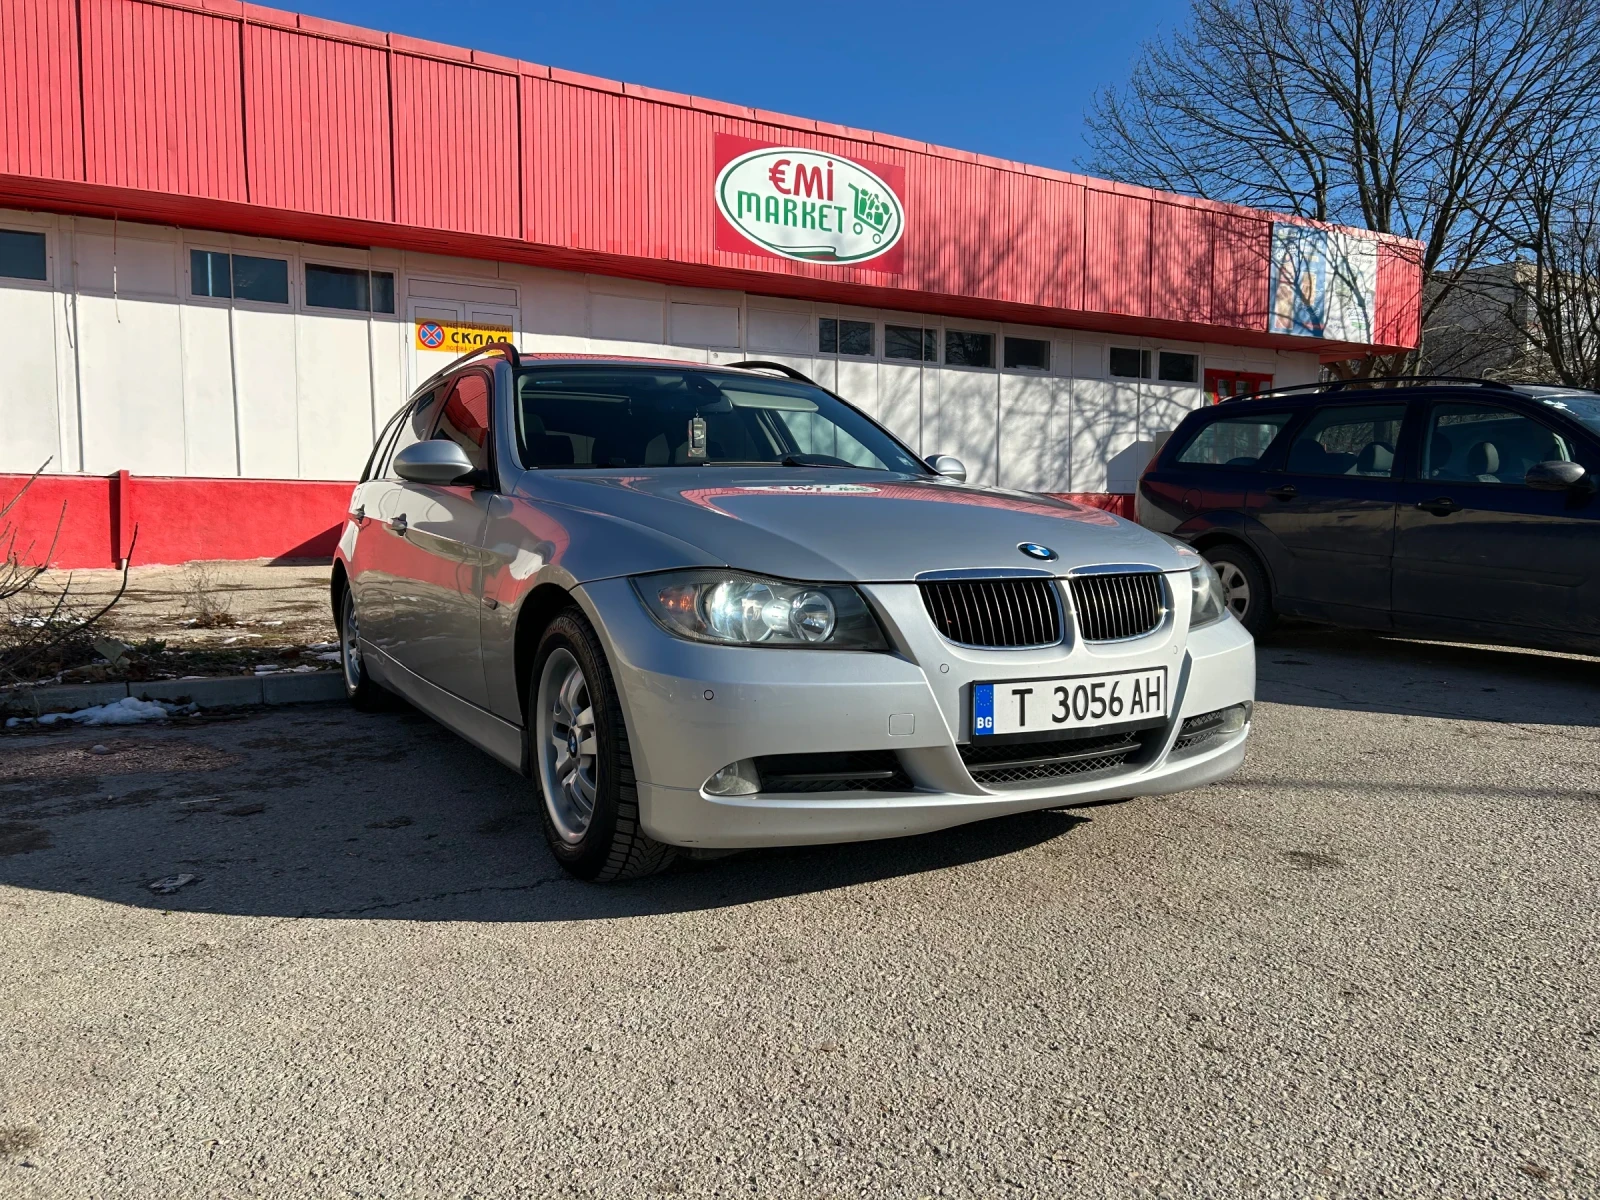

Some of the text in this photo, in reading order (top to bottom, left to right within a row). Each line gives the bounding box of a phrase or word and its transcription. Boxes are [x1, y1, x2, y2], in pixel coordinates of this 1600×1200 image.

[737, 190, 847, 234] MARKET
[976, 717, 992, 728] BG
[1012, 676, 1161, 726] T 3056 AH
